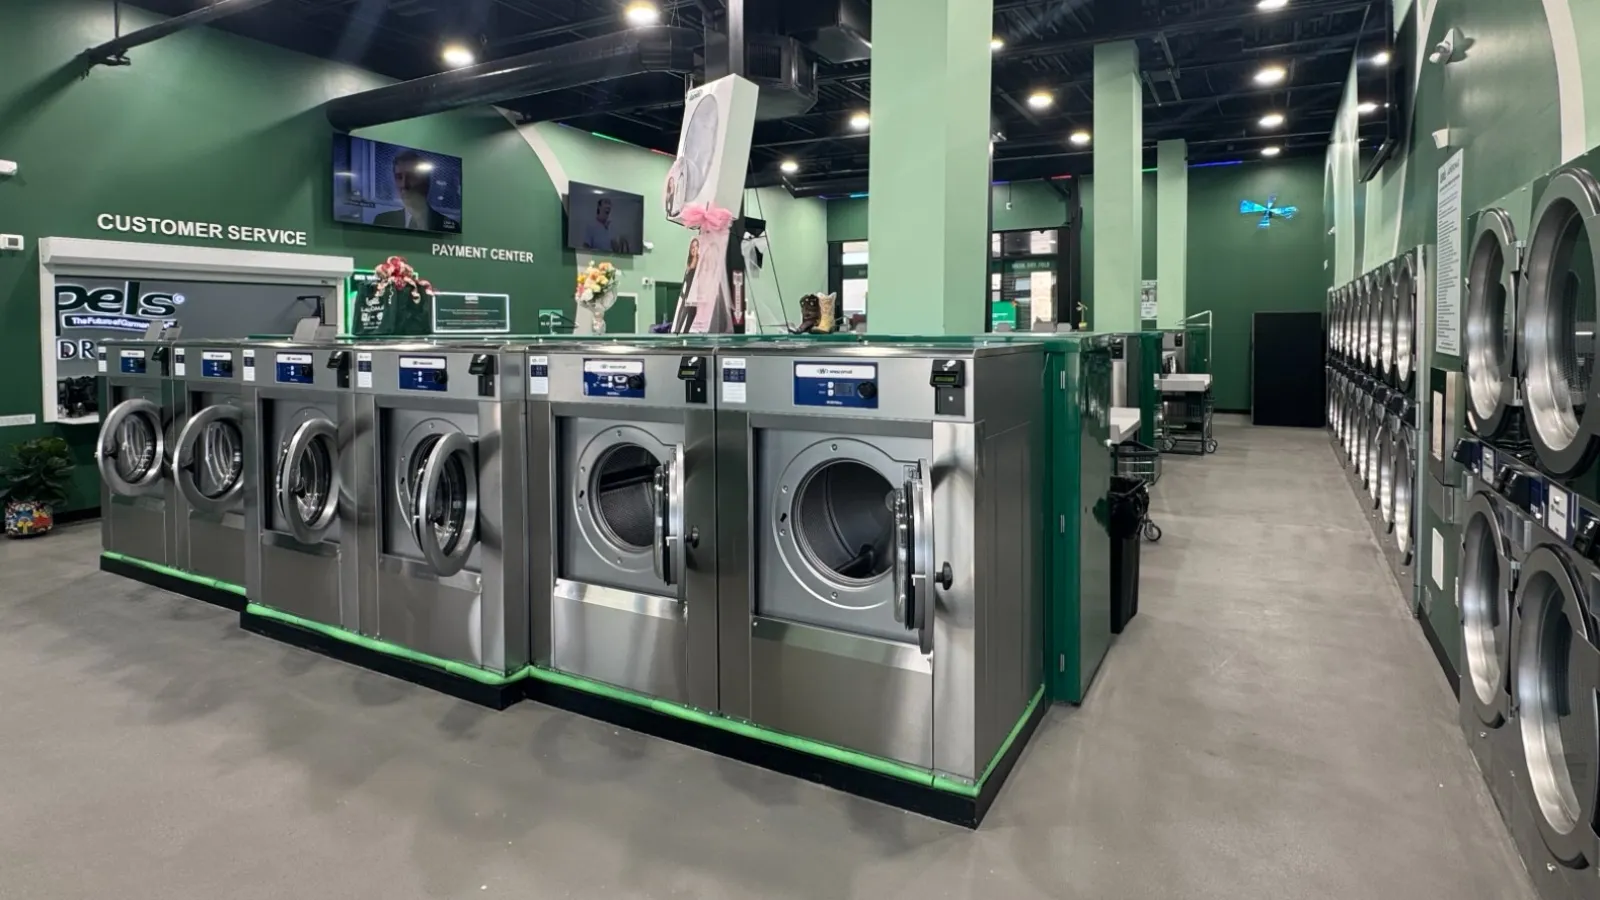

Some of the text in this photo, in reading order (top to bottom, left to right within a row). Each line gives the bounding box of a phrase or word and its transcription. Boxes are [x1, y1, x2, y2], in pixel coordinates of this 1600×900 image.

[97, 213, 307, 246] CUSTOMER SERVICE
[432, 243, 534, 264] PAYMENT CENTER
[71, 317, 150, 329] The Future of Garmen
[57, 339, 96, 360] DR
